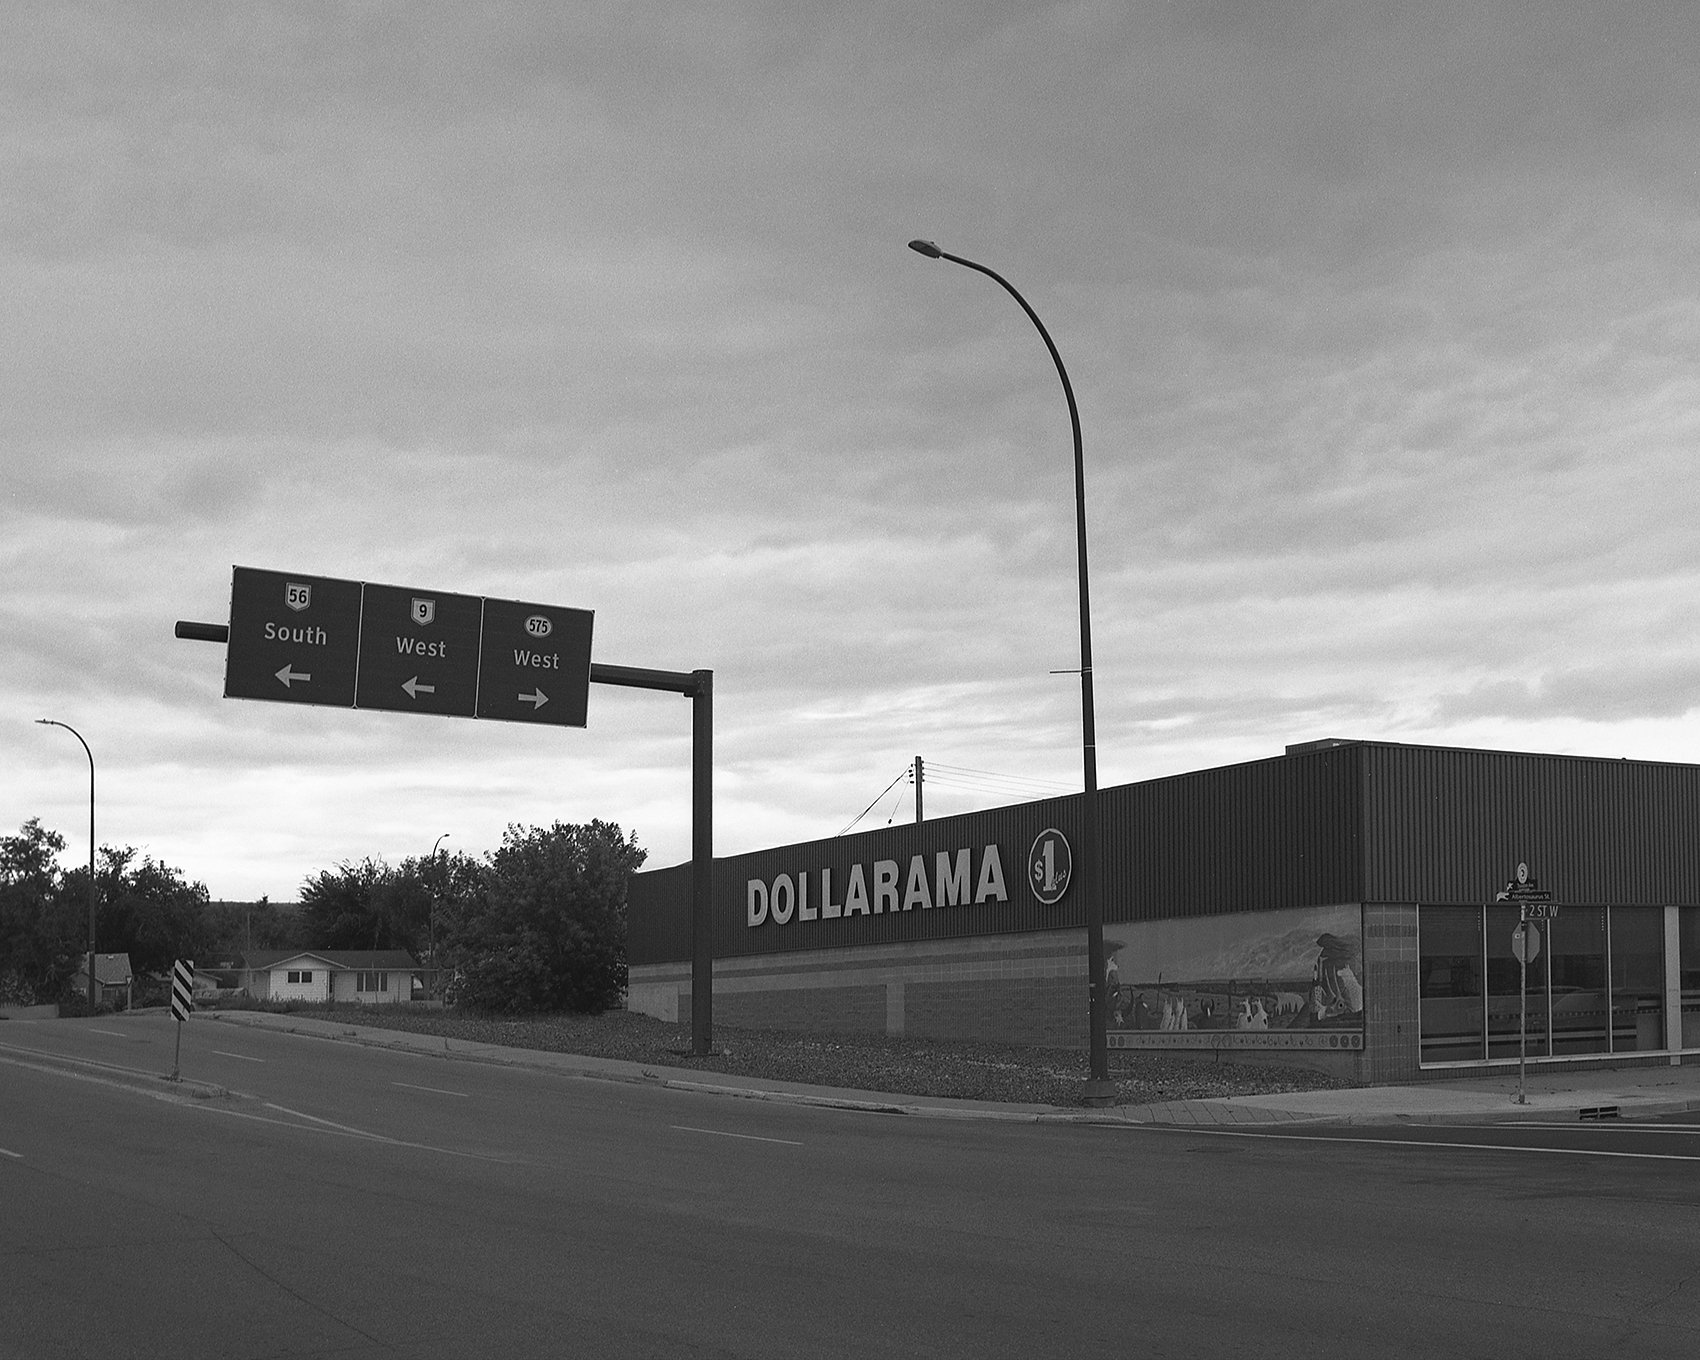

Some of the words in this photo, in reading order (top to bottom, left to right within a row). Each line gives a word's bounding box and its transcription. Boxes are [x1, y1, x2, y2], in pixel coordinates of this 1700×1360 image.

[289, 588, 308, 604] 56
[418, 603, 428, 618] 9
[264, 622, 328, 646] South
[528, 618, 549, 634] 575
[395, 636, 447, 658] West
[513, 649, 560, 669] West
[1034, 839, 1058, 892] $1
[747, 844, 1009, 927] DOLLARAMA
[1529, 904, 1535, 917] 2
[1537, 904, 1548, 917] ST
[1549, 905, 1559, 917] W
